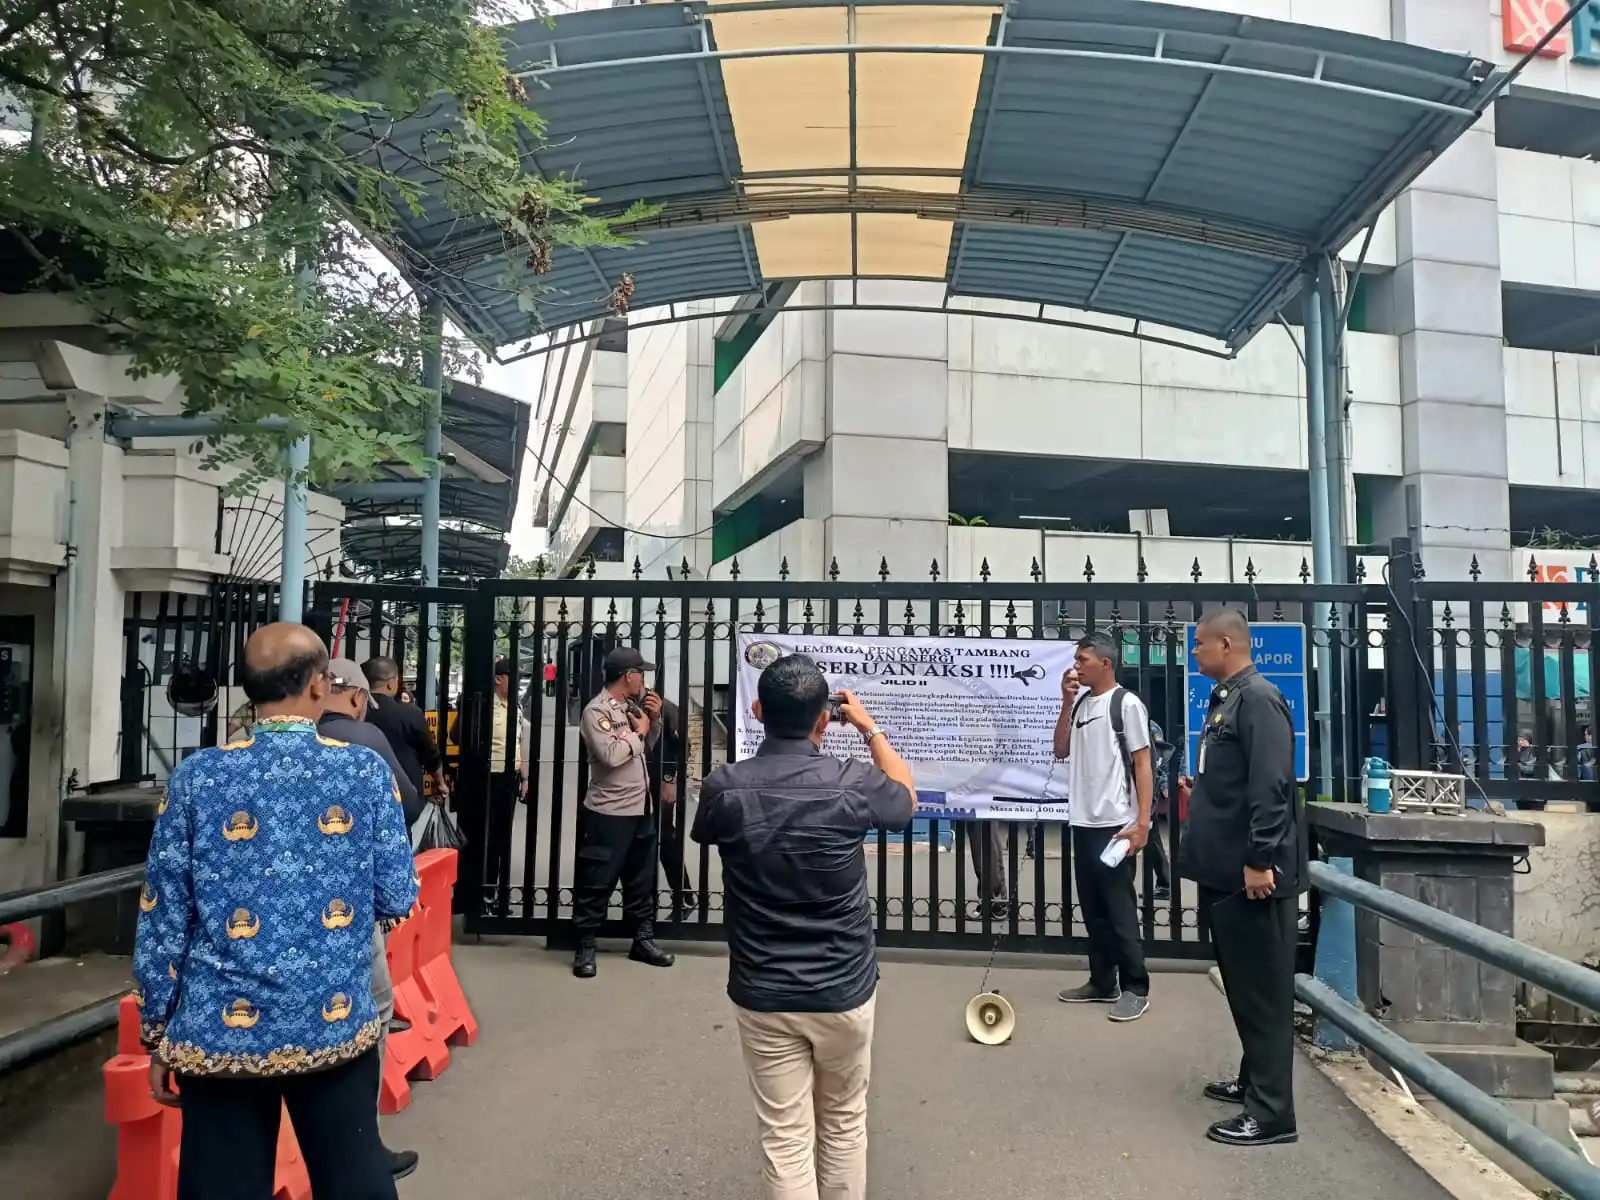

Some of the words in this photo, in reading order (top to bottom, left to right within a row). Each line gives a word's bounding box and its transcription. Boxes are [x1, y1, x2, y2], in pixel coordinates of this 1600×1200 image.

[795, 645, 864, 655] LEMBAGA
[867, 646, 951, 656] PENGAWAS
[954, 648, 1031, 658] TAMBANG
[864, 653, 895, 662] DAN
[899, 654, 954, 664] ENERGI
[1255, 653, 1293, 665] APOR
[816, 661, 917, 676] SERUAN
[924, 664, 984, 678] AKSI
